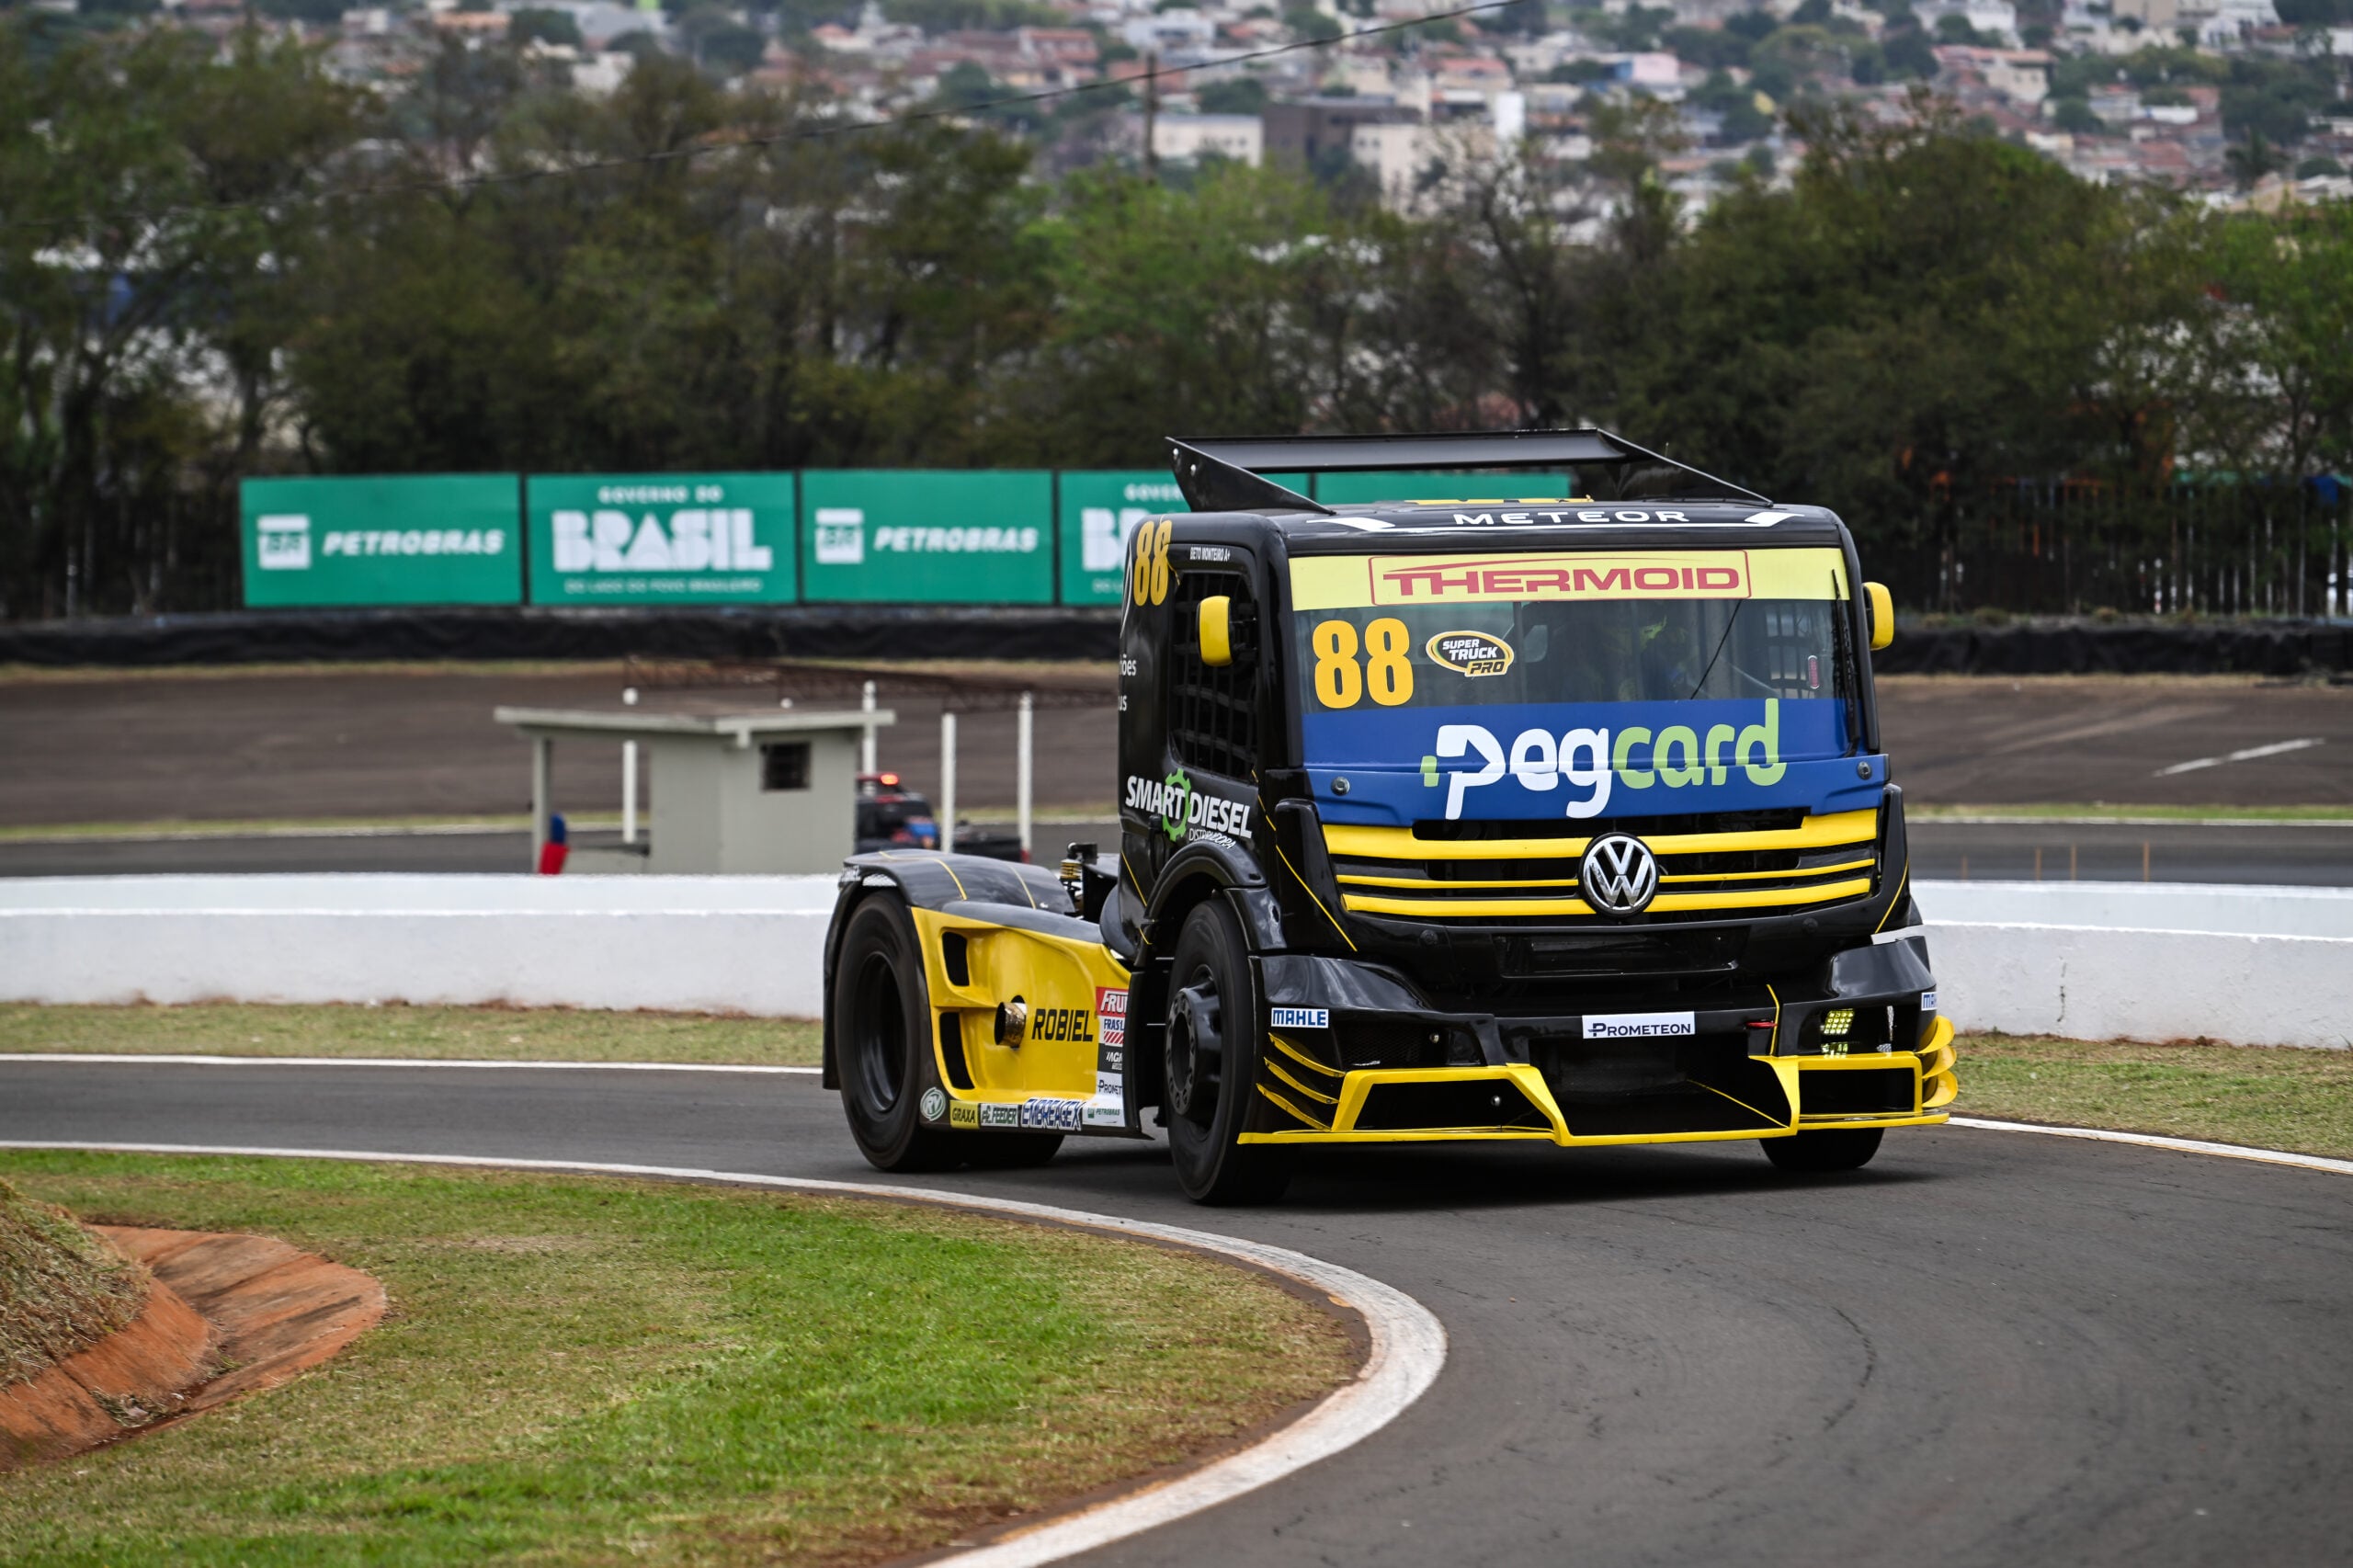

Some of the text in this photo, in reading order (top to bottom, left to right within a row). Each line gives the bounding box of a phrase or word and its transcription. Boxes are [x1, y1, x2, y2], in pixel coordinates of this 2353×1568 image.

[1453, 510, 1689, 526] METEOR
[323, 529, 505, 556] PETROBRAS
[551, 509, 773, 572] BRASIL
[874, 527, 1039, 552] PETROBRAS
[1133, 519, 1173, 607] 88
[1382, 566, 1740, 597] THERMOID
[1442, 639, 1480, 650] SUPER
[1449, 647, 1498, 661] TRUCK
[1312, 618, 1414, 709] 88
[1470, 661, 1505, 674] PRO
[1125, 776, 1252, 838] SMART DIESEL
[1031, 1009, 1093, 1041] ROBIEL
[1272, 1009, 1327, 1028] MAHLE
[952, 1108, 975, 1123] GRAXA
